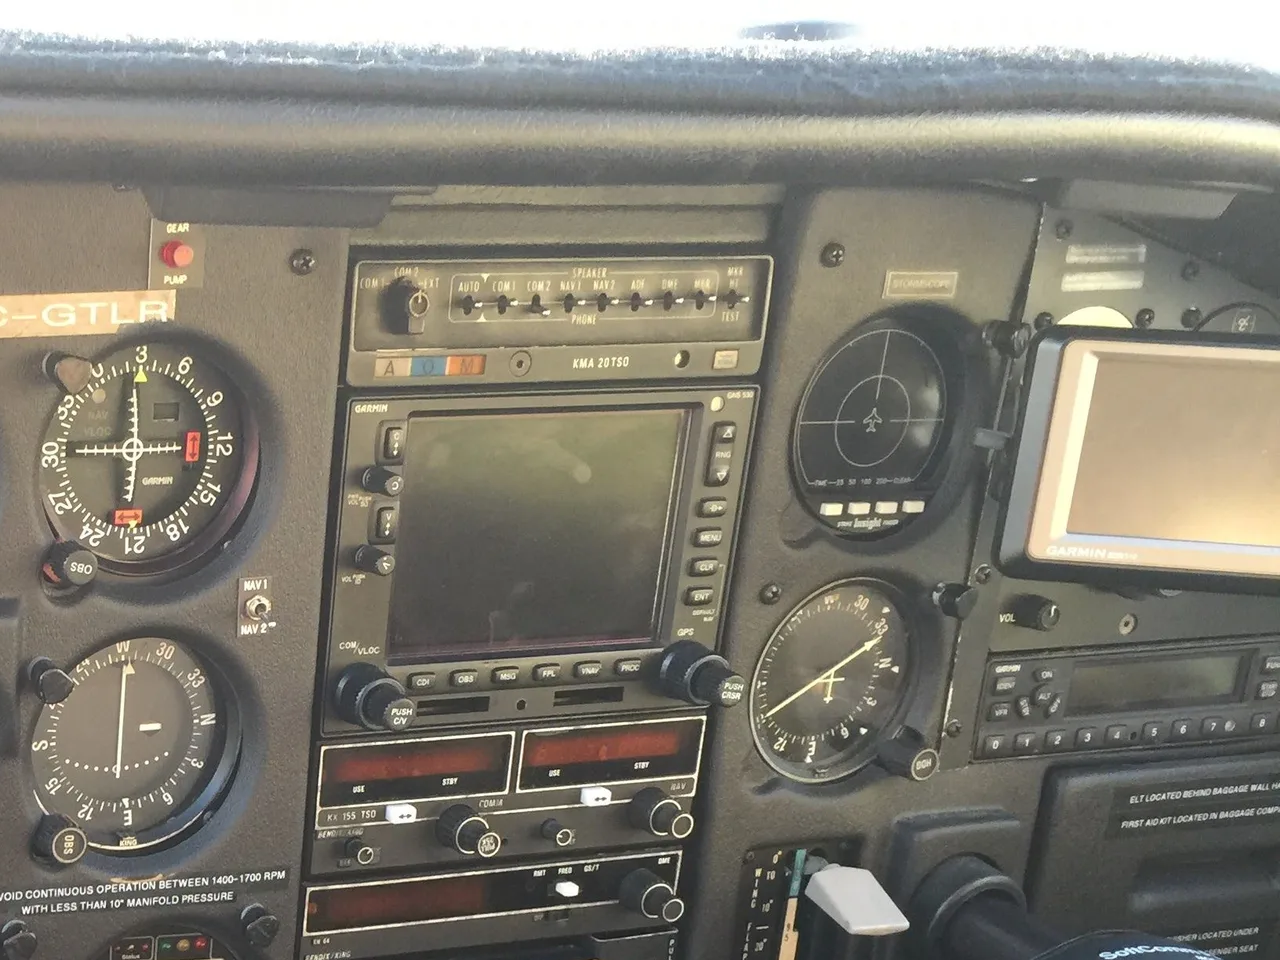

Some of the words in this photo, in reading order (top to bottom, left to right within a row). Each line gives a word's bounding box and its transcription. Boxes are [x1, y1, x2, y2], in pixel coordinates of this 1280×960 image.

[167, 222, 189, 233] GEAR
[573, 268, 608, 279] SPEAKER
[164, 275, 187, 284] PUMP
[571, 313, 597, 324] PHONE
[573, 358, 594, 369] KMA
[143, 477, 173, 485] GARMIN
[70, 562, 93, 575] OBS
[244, 580, 262, 590] NAV
[1000, 614, 1016, 623] VOL
[241, 624, 260, 635] NAV
[677, 628, 694, 636] GPS
[1130, 794, 1145, 803] ELT
[1145, 791, 1182, 802] LOCATED
[1183, 789, 1211, 798] BEHIND
[1212, 785, 1249, 795] BAGGAGE
[1250, 782, 1269, 791] WALL
[25, 886, 92, 899] CONTINUOUS
[97, 882, 157, 894] OPERATION
[159, 877, 209, 890] BETWEEN
[211, 872, 261, 885] 1400-1700
[264, 870, 286, 881] RPM
[22, 904, 48, 915] WITH
[51, 902, 77, 913] LESS
[80, 899, 107, 910] THAN
[127, 895, 179, 907] MANIFOLD
[182, 891, 234, 903] PRESSURE
[1198, 930, 1232, 940] LOCATED
[1234, 927, 1259, 936] UNDER
